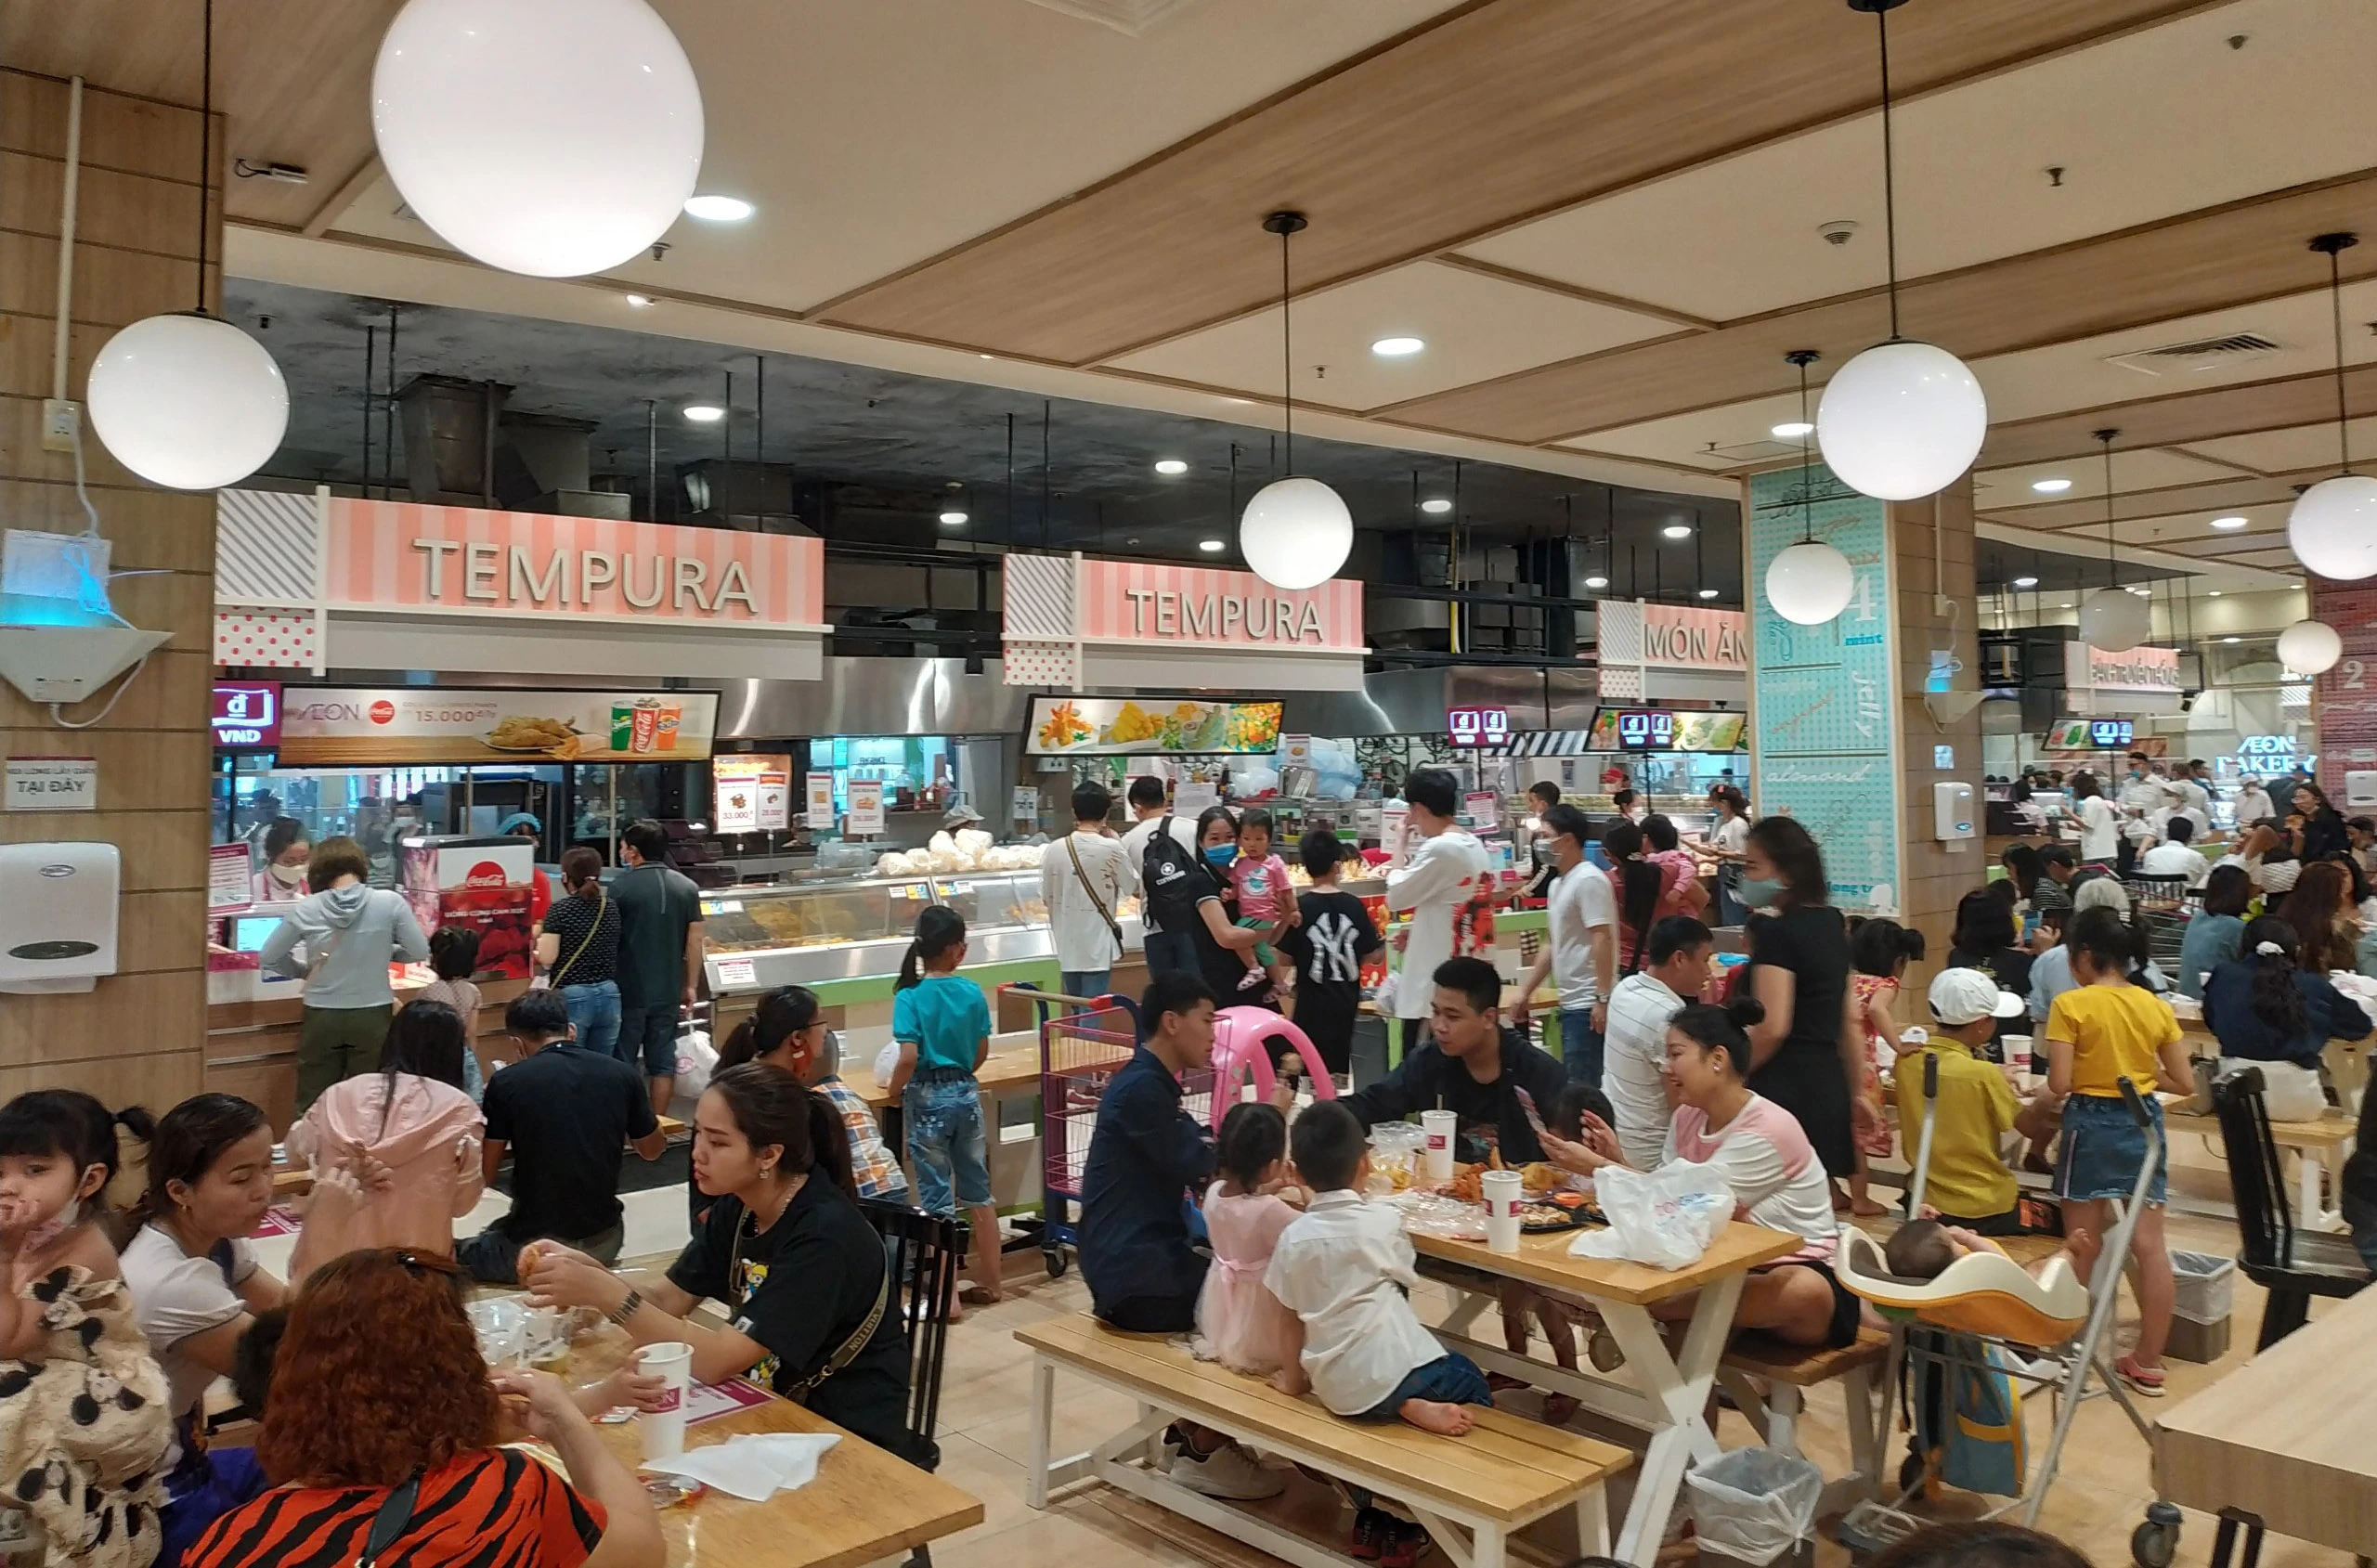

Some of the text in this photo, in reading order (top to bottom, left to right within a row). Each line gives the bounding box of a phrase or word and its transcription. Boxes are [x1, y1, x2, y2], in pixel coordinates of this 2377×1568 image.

[411, 538, 760, 615] TEMPURA
[1126, 589, 1324, 641] TEMPURA
[1643, 618, 1708, 661] MÓN
[2342, 660, 2366, 690] 2
[848, 1313, 879, 1352] VUITTON
